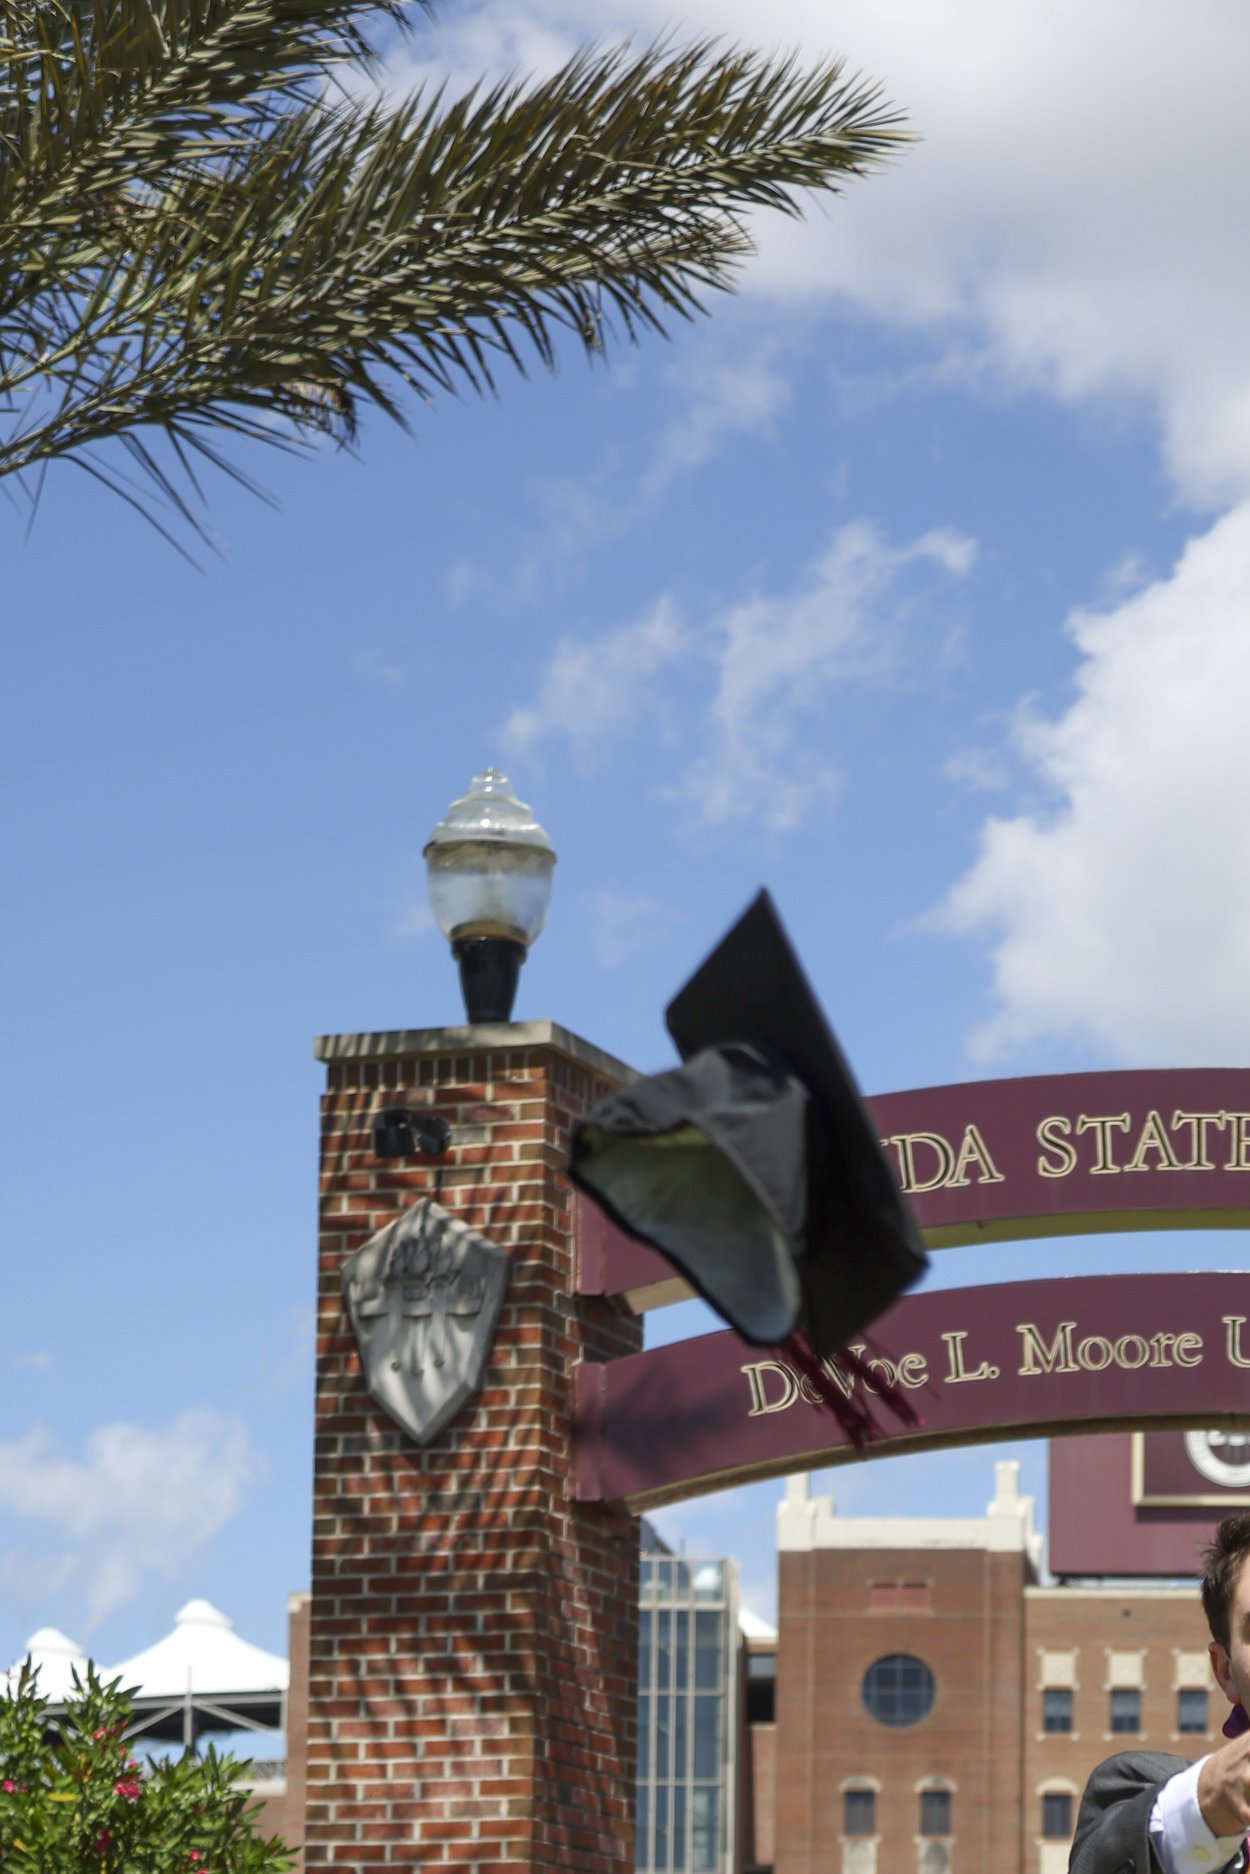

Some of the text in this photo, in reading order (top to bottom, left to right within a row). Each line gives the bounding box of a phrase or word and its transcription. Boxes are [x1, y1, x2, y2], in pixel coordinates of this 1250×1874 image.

[880, 1124, 1005, 1193] DA
[940, 1331, 1000, 1383] L.
[1015, 1321, 1203, 1376] Moore
